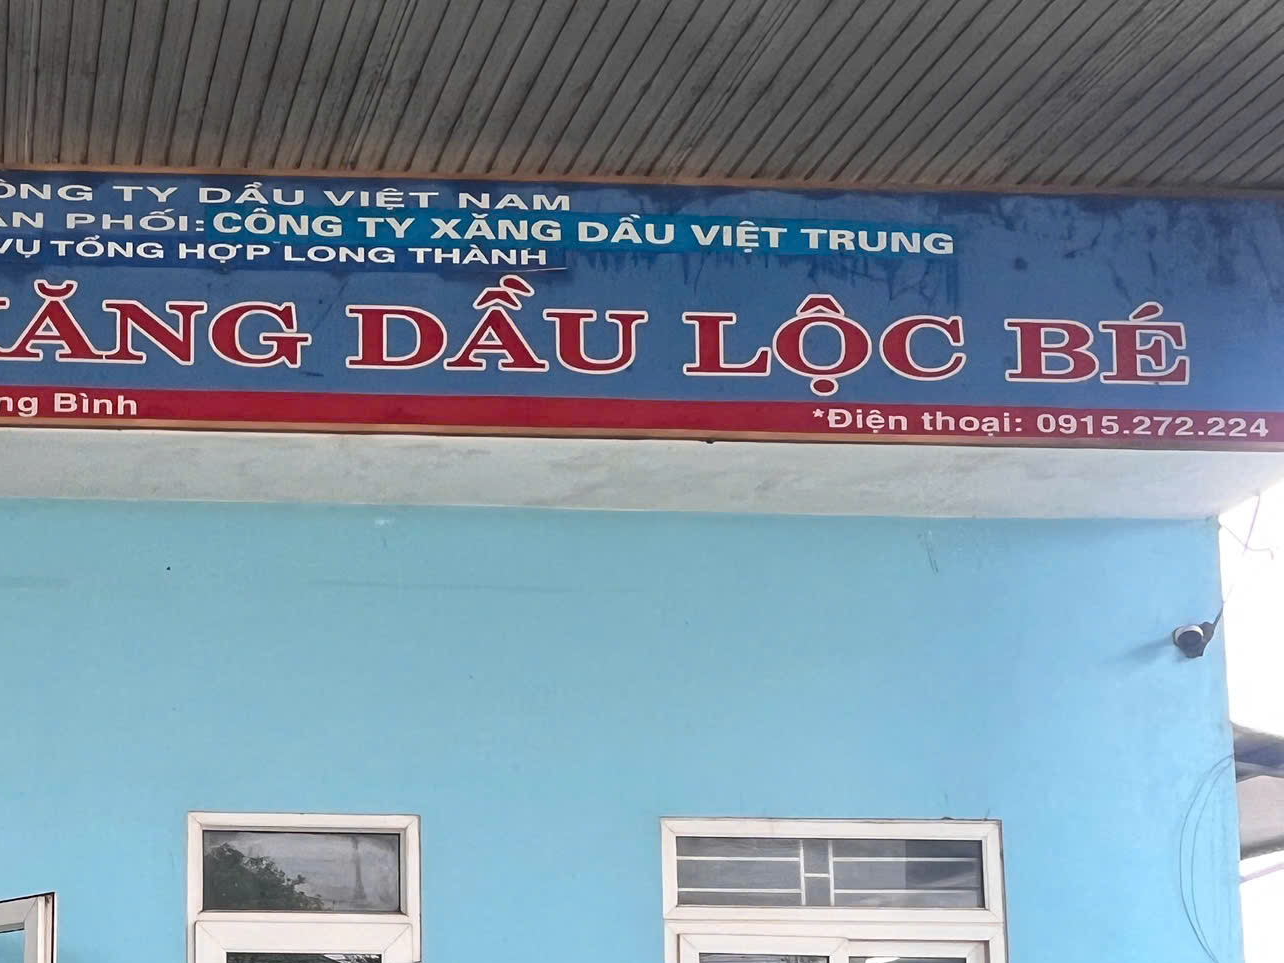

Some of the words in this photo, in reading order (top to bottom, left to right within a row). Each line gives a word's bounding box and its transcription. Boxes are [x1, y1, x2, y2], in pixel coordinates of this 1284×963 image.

[113, 186, 177, 202] TY
[199, 181, 304, 206] DẦU
[324, 188, 439, 210] VIỆT
[459, 192, 570, 212] NAM
[67, 209, 205, 233] PHỐI:
[214, 208, 342, 236] CÔNG
[358, 218, 414, 238] TY
[431, 213, 561, 241] XĂNG
[579, 214, 674, 244] DẦU
[691, 221, 787, 252] VIỆT
[801, 229, 953, 254] TRUNG
[50, 235, 163, 258] TỔNG
[179, 243, 271, 262] HỢP
[285, 246, 395, 263] LONG
[415, 246, 546, 265] THÀNH
[345, 275, 648, 374] DẦU
[682, 294, 966, 396] LỘC
[1004, 302, 1190, 385] BÉ
[55, 393, 136, 415] Bình
[922, 411, 1023, 436] thoại:
[1037, 413, 1269, 438] 0915.272.224
